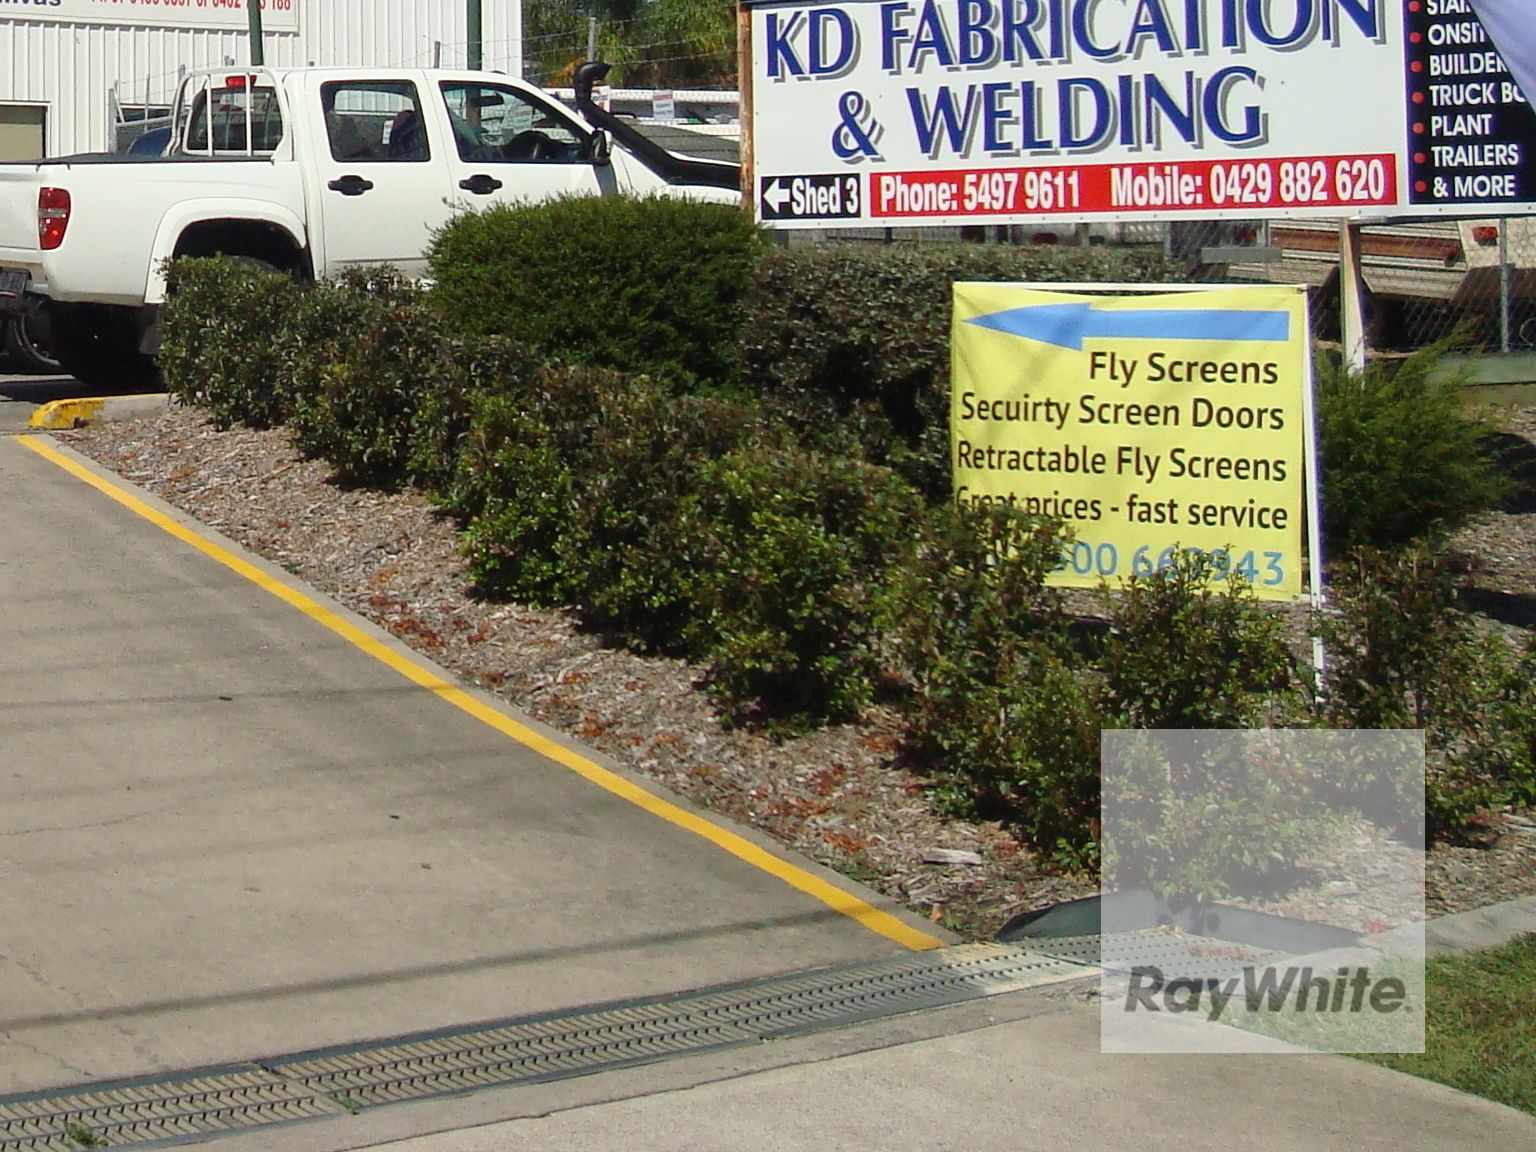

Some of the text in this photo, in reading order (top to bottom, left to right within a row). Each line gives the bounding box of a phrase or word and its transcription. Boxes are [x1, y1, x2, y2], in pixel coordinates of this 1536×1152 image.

[766, 8, 859, 81] KD
[1428, 22, 1485, 45] ONSIT
[1429, 82, 1496, 106] TRUCK
[832, 66, 1269, 164] & WELDING
[1431, 113, 1492, 137] PLANT
[1431, 144, 1519, 167] TRAILERS
[792, 178, 859, 215] Shed 3
[880, 159, 1385, 212] Phone: 5497 9611 Mobile: 0429 882 620
[1433, 175, 1515, 198] & MORE
[1089, 351, 1279, 388] Fly Screens
[961, 392, 1285, 430] Secuirty Screen Doors
[957, 440, 1287, 484] Retractable Fly Screens
[956, 486, 1017, 516] Grt
[1127, 494, 1179, 525] fast
[1188, 499, 1288, 529] service
